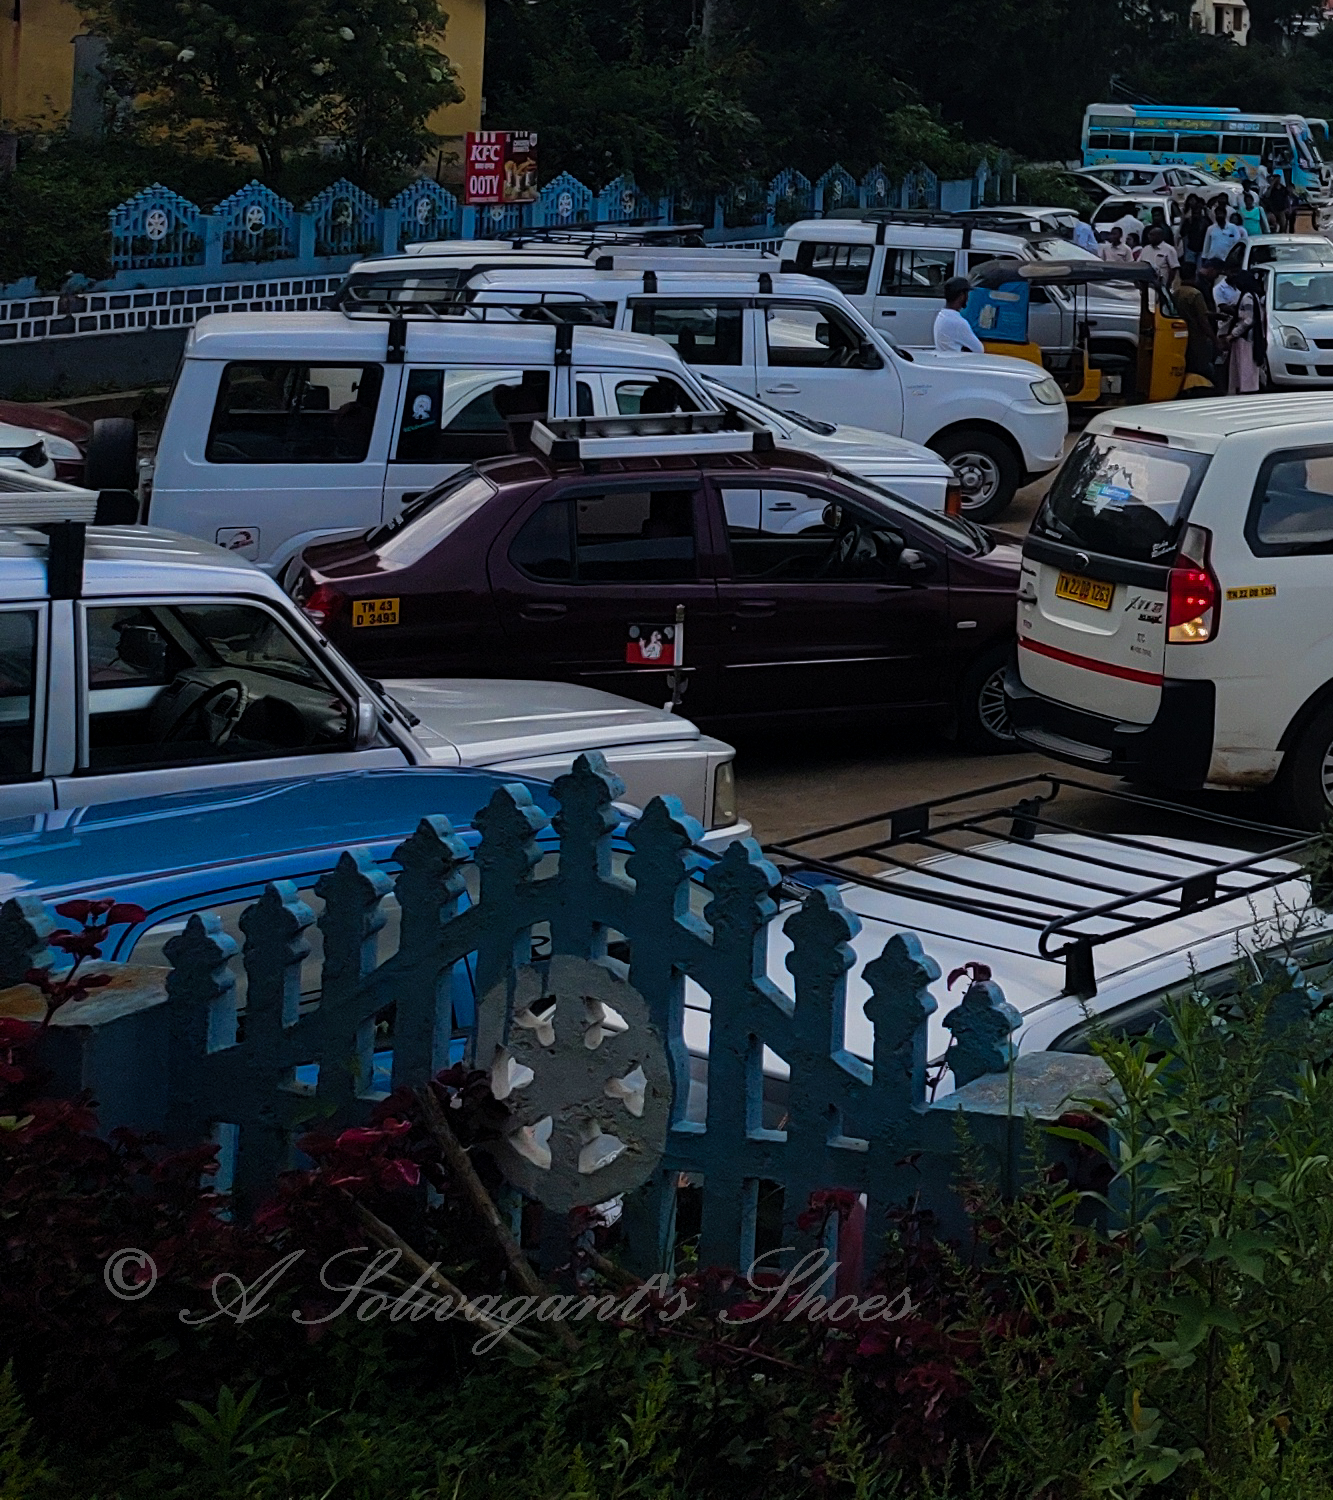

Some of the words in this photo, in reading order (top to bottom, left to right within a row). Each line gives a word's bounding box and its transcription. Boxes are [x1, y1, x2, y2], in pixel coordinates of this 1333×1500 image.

[470, 144, 501, 161] KFC
[469, 174, 500, 195] OOTY
[1060, 575, 1069, 592] TN
[1069, 578, 1079, 595] 22
[362, 602, 375, 613] TN
[380, 600, 392, 611] 43
[369, 612, 396, 624] 3493
